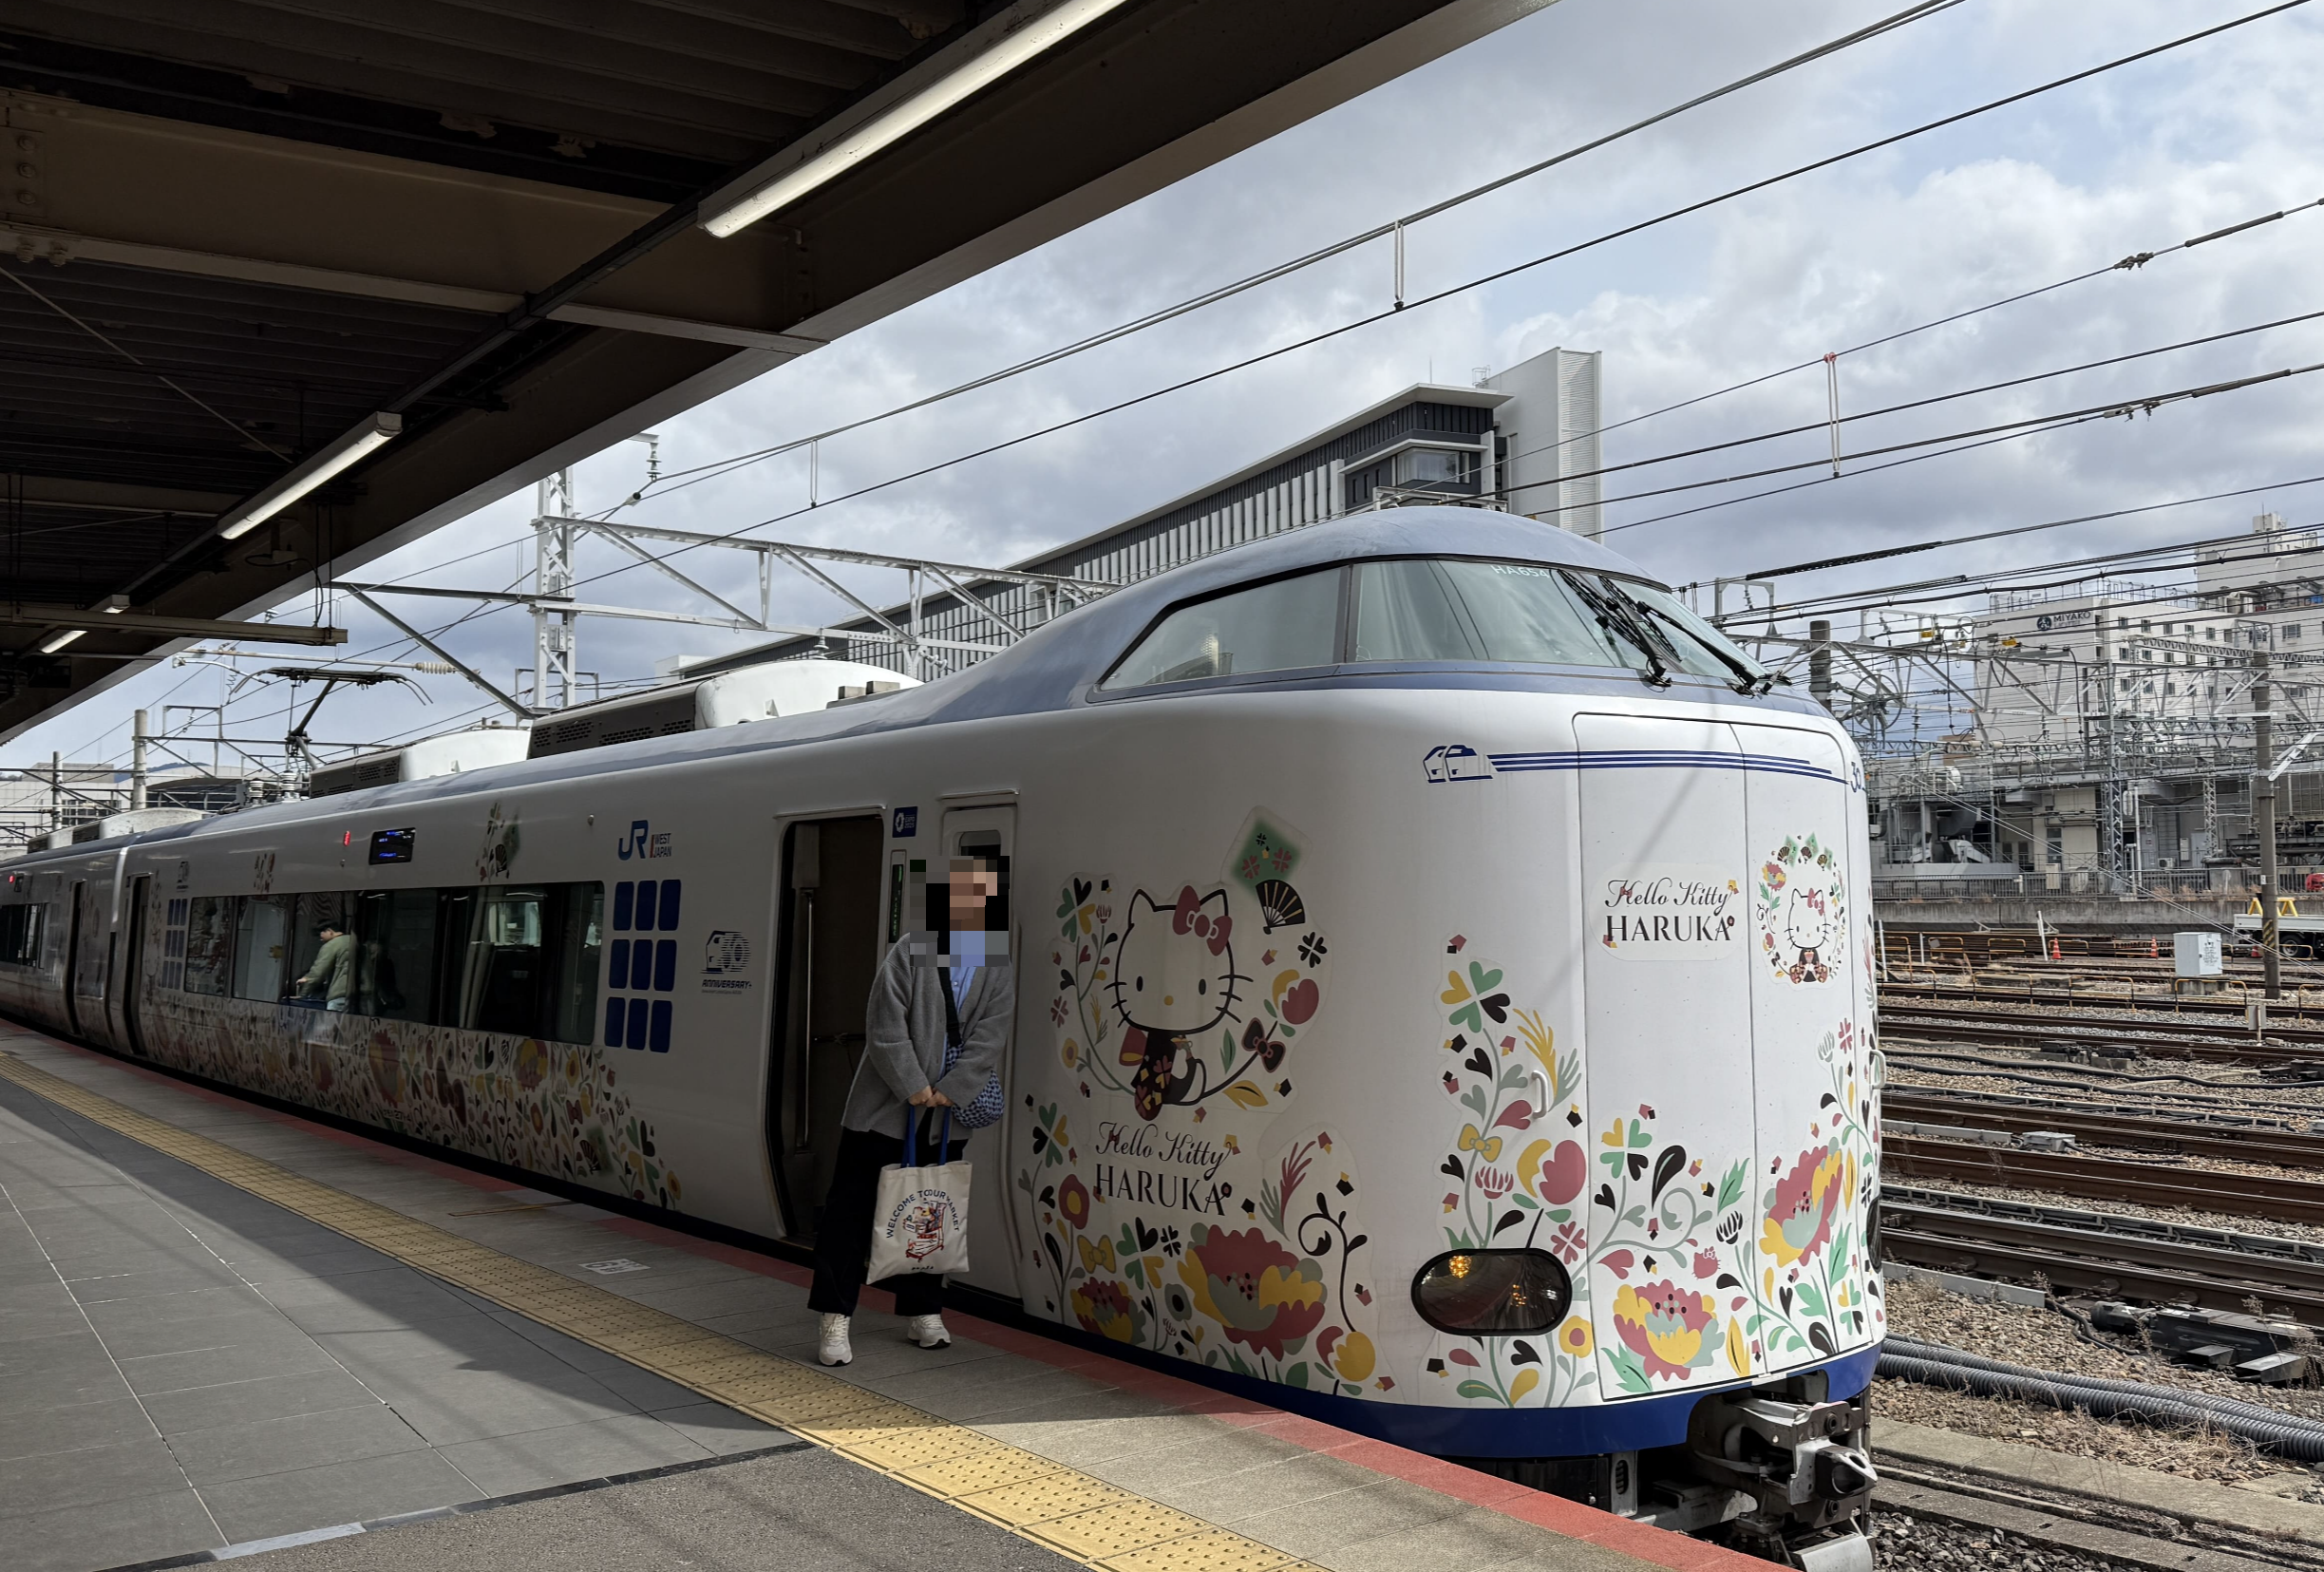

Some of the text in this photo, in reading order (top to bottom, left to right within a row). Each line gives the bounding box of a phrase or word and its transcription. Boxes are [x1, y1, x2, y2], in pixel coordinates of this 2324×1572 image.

[1490, 564, 1550, 578] HA654
[2053, 611, 2091, 623] MIYAKO
[618, 820, 649, 861] JR
[652, 846, 672, 858] JAPAN
[653, 833, 672, 845] WEST
[1605, 877, 1733, 916] Hello Kitty
[1606, 915, 1734, 941] HARUKA
[1095, 1121, 1233, 1182] Hello Kitty
[1096, 1163, 1232, 1217] HARUKA
[886, 1194, 916, 1239] WELCOME
